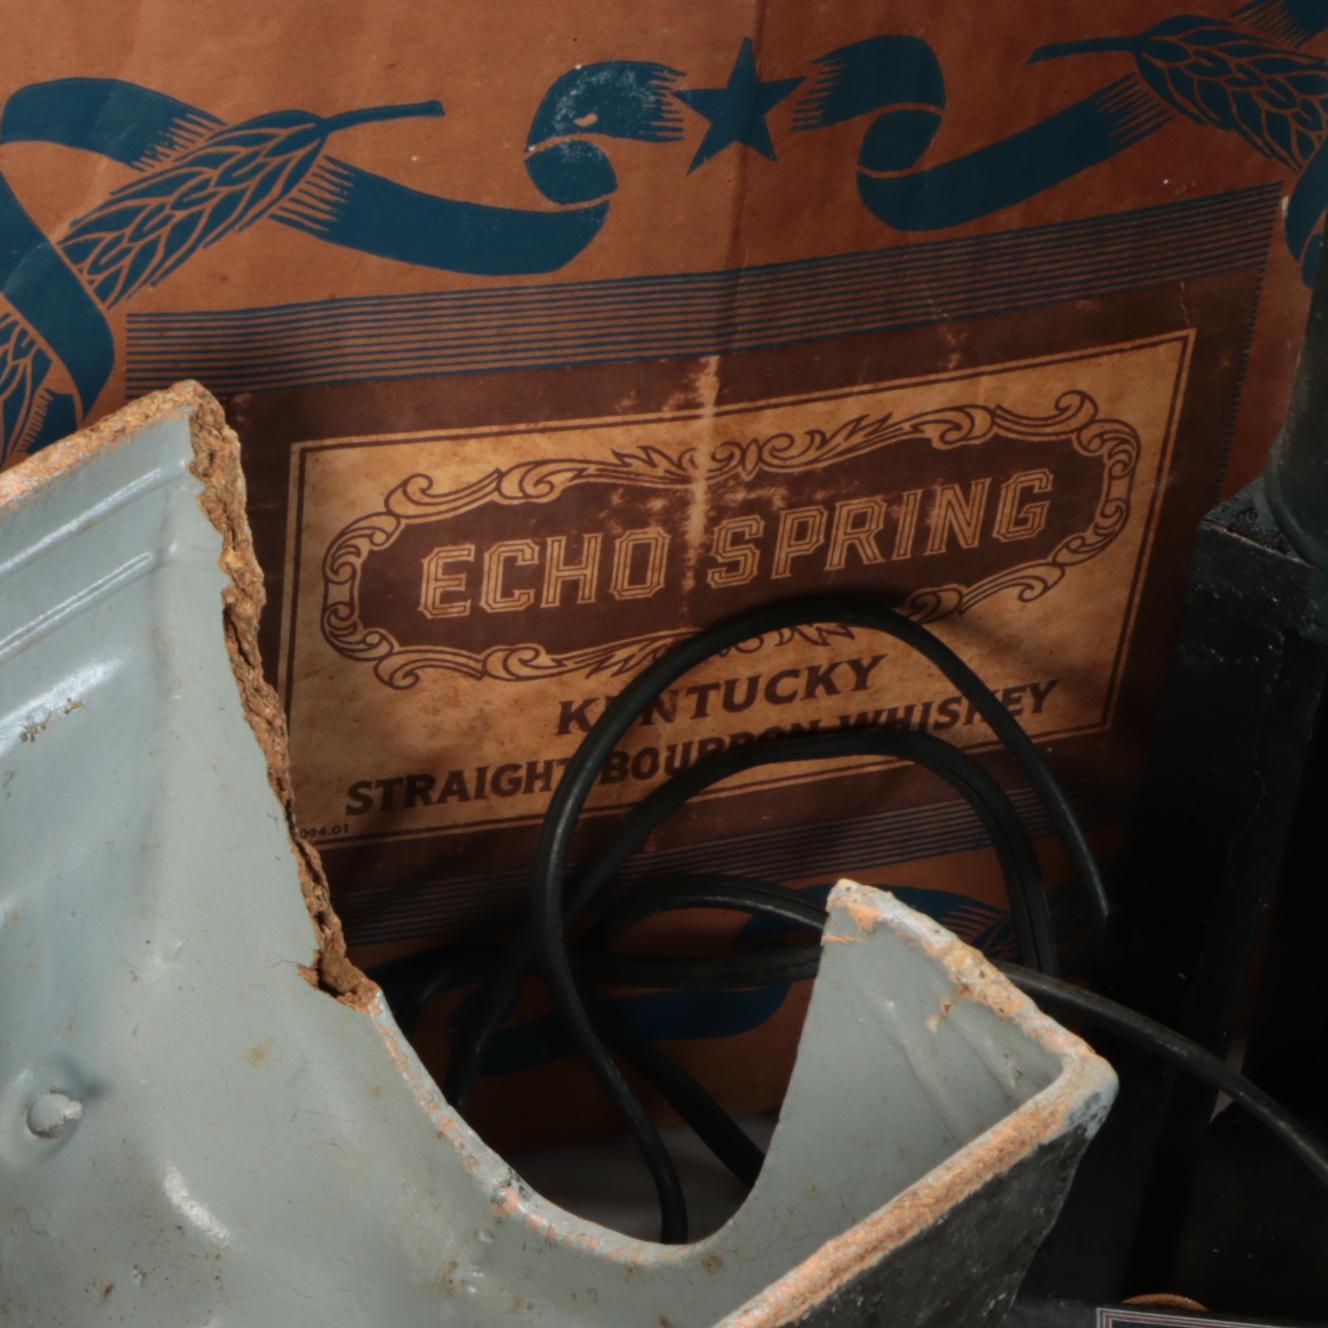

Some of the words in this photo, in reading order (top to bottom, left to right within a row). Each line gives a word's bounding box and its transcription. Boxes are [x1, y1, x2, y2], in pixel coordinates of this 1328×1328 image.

[417, 527, 671, 620] ECHO
[707, 467, 1055, 589] SPRING
[556, 654, 887, 735] KNTUCKY
